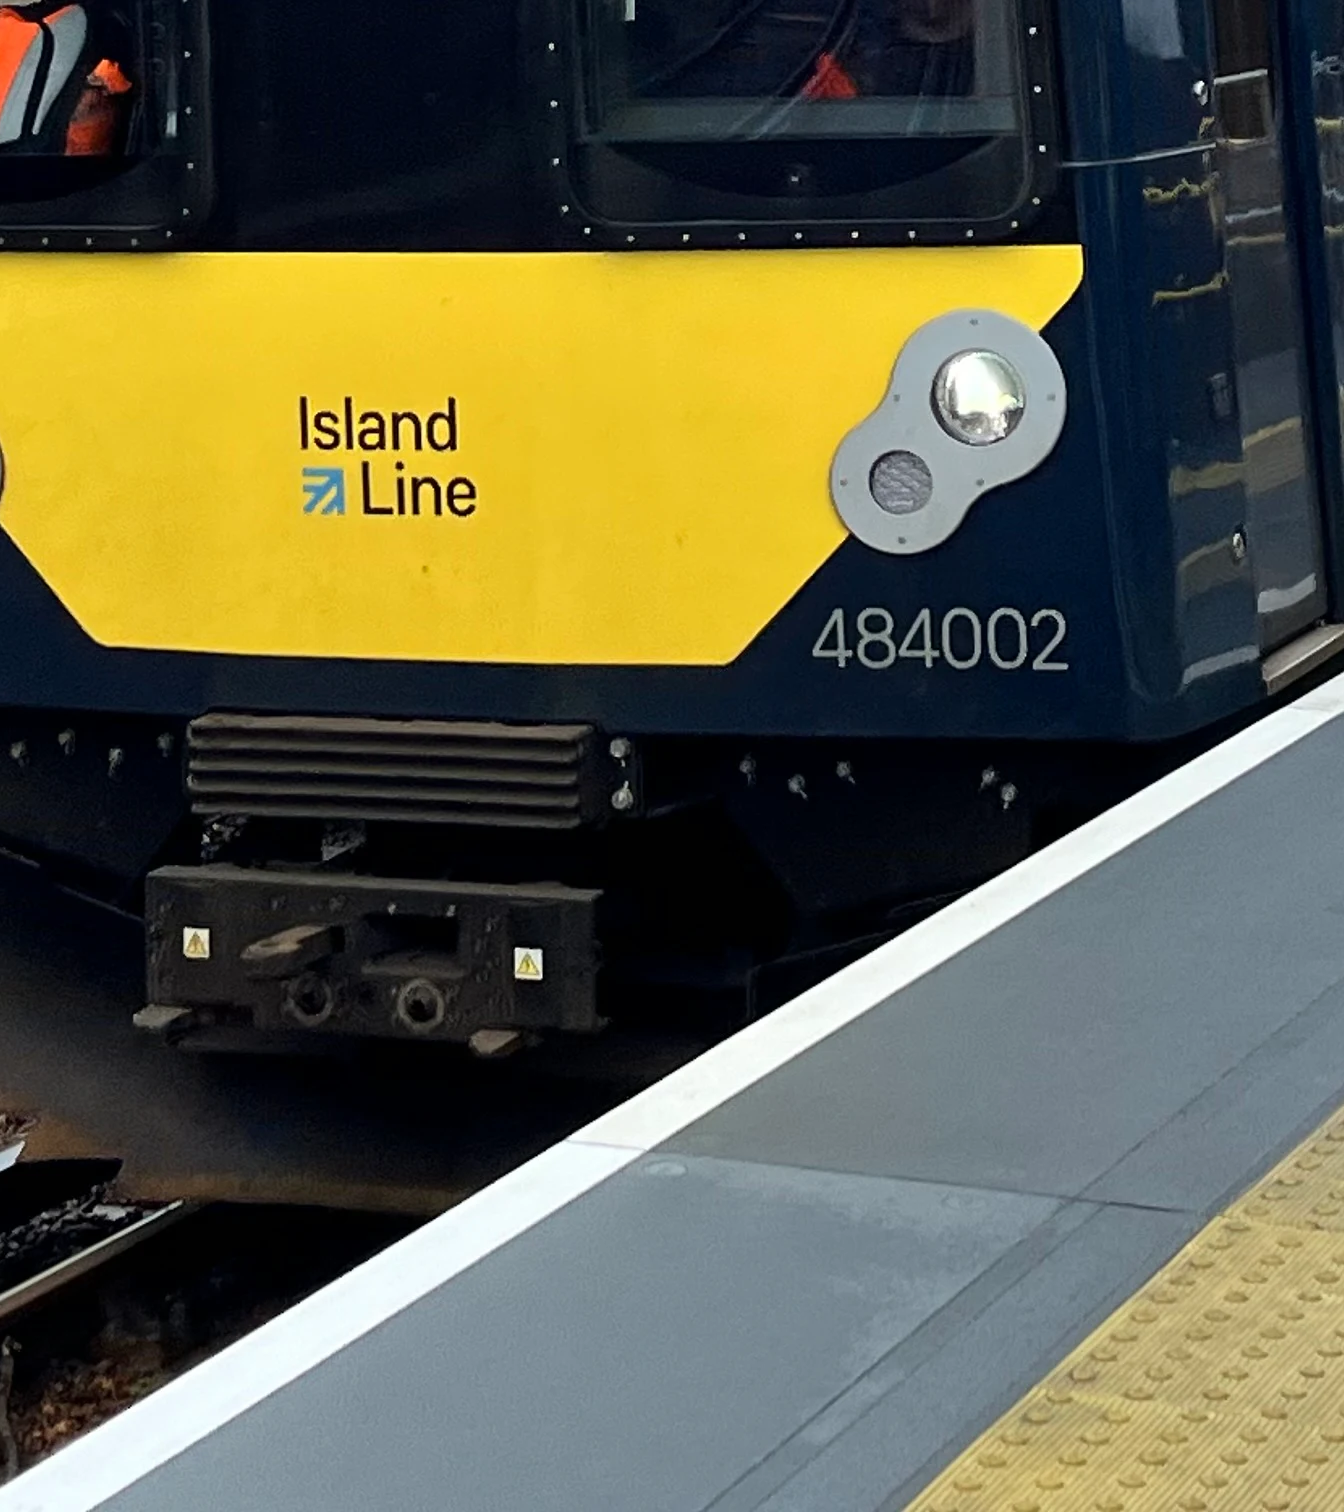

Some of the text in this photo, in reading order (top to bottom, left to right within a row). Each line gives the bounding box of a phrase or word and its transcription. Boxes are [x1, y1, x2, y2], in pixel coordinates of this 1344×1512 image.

[299, 395, 458, 452] Island
[361, 460, 477, 517] Line
[812, 607, 1069, 670] 484002
